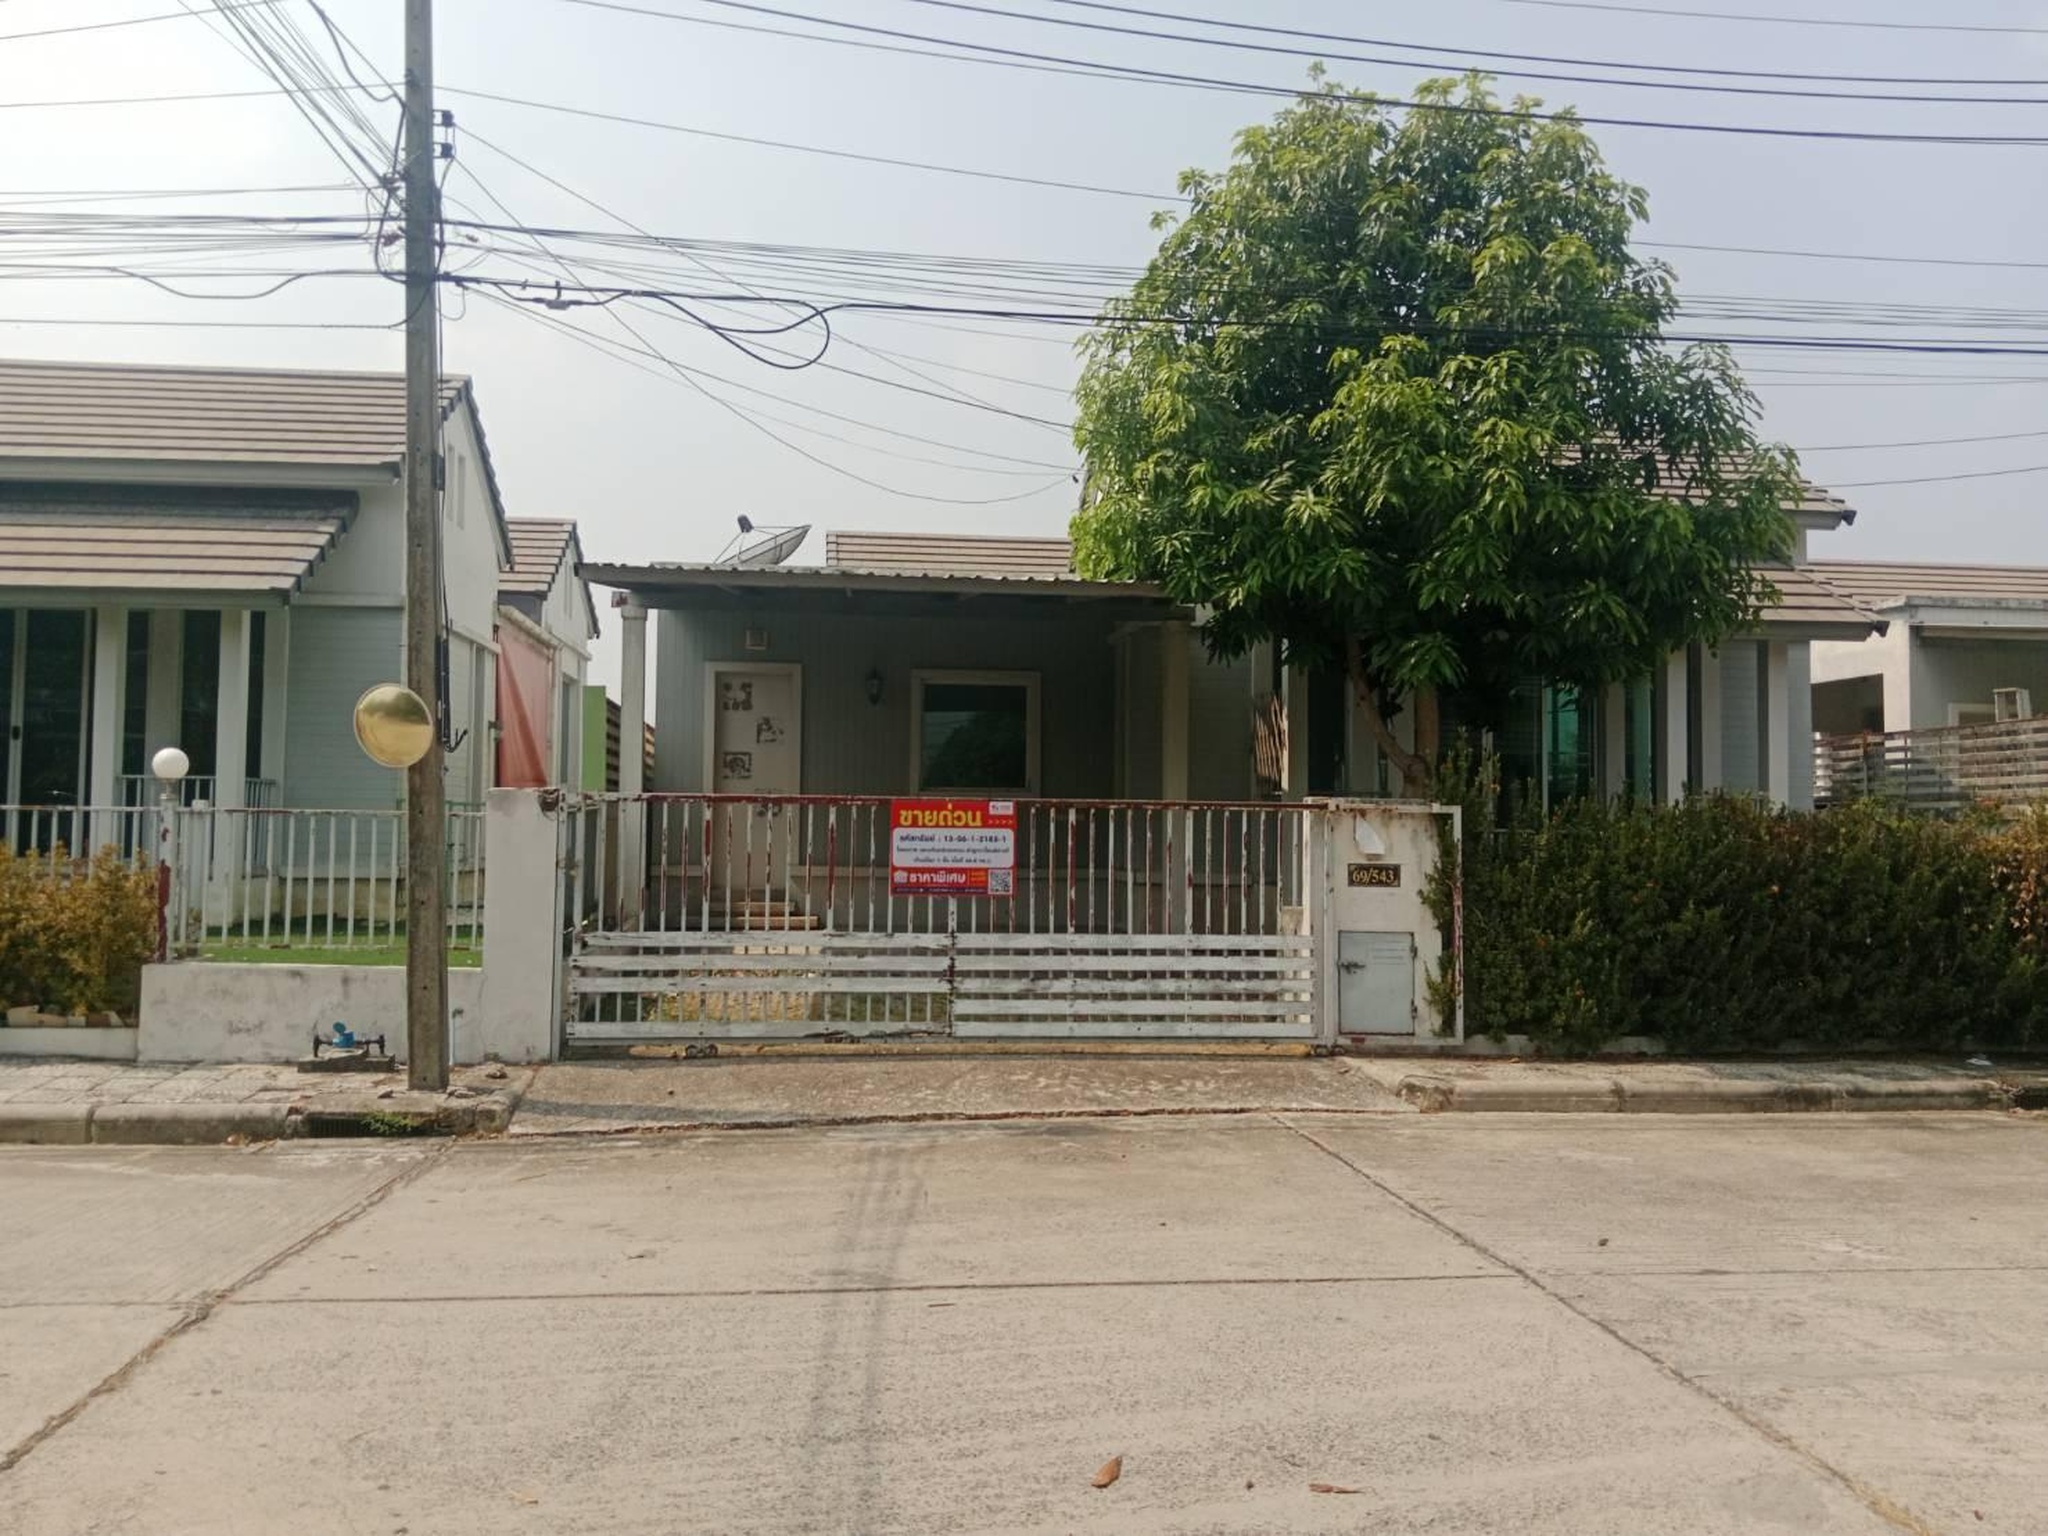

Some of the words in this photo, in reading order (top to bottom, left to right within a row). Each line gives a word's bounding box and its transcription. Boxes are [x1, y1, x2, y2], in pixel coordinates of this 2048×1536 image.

[899, 802, 982, 826] ขายด่วน
[909, 870, 966, 883] ราคาพิเศษ
[1352, 867, 1395, 885] 69/543
